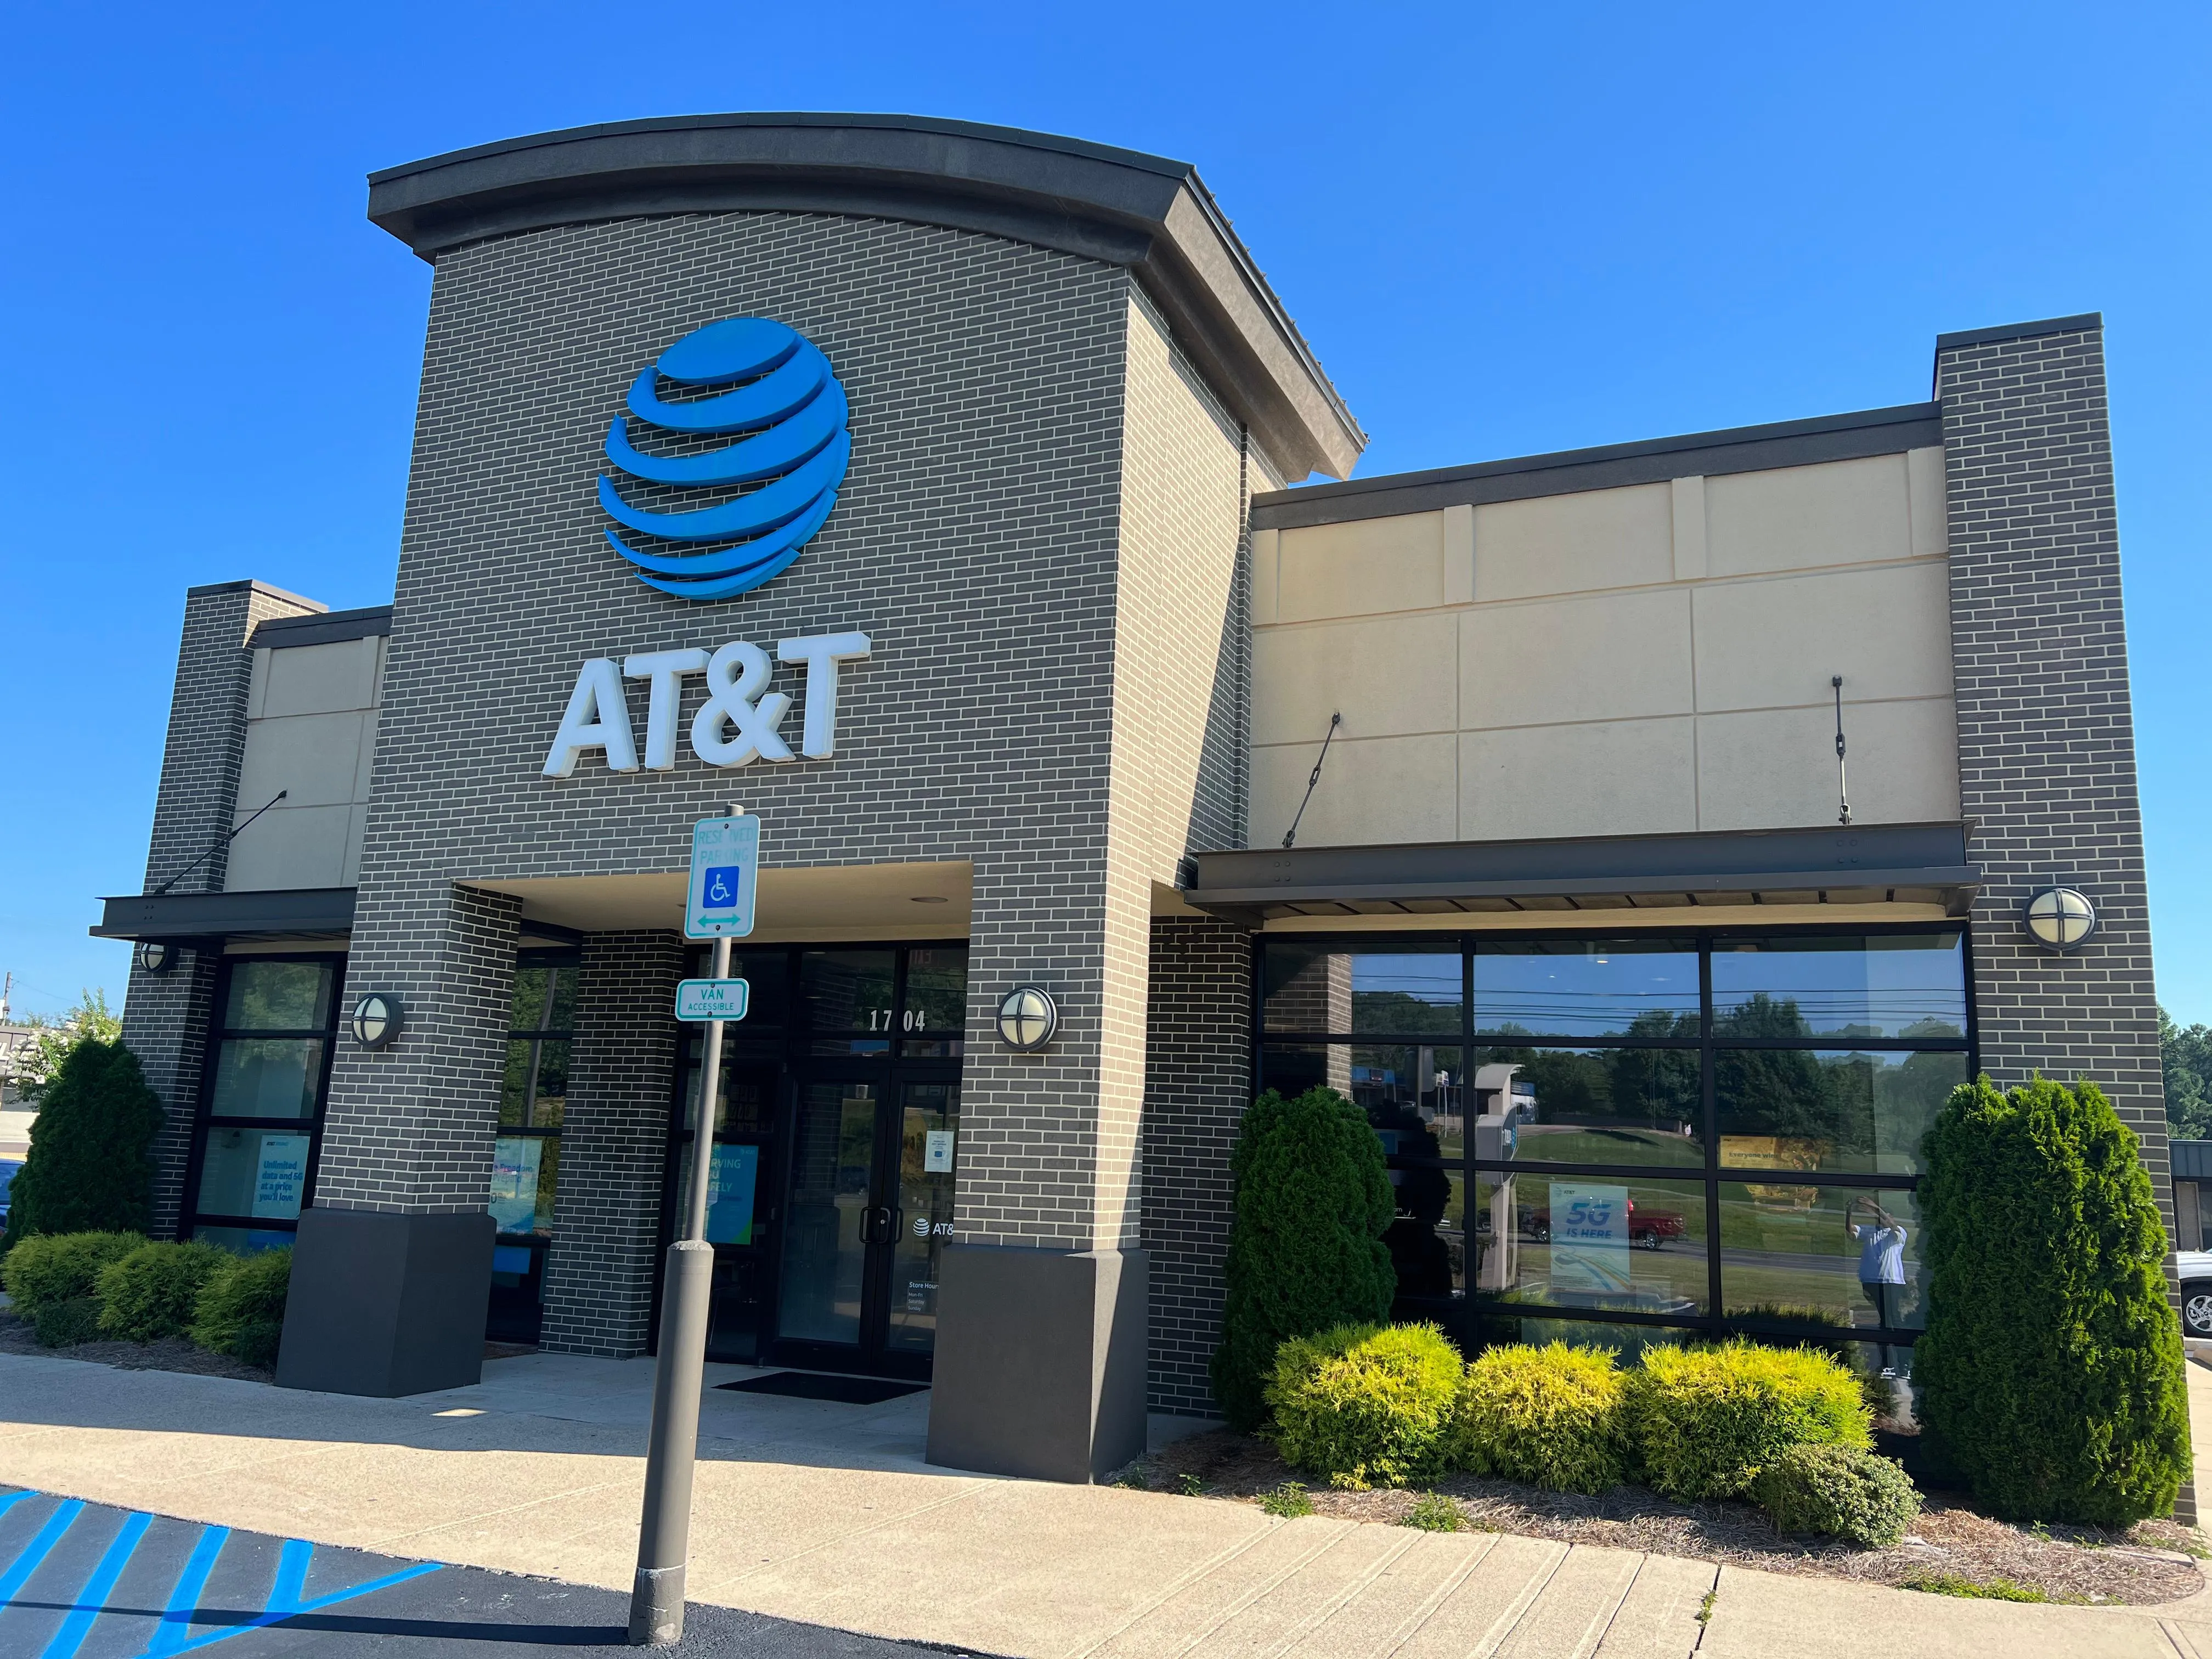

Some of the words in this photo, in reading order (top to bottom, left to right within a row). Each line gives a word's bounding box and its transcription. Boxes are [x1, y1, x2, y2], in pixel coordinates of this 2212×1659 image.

[542, 631, 871, 778] AT&T
[701, 989, 724, 1000] VAN
[264, 1161, 297, 1169] Unlimited
[500, 1164, 533, 1172] Freedom
[711, 1159, 741, 1169] RVING
[262, 1171, 278, 1179] data
[279, 1172, 292, 1180] and
[293, 1172, 303, 1181] 5G
[274, 1182, 292, 1193] price
[259, 1193, 278, 1202] you'll
[279, 1193, 294, 1201] love
[1566, 1202, 1611, 1226] 5G
[932, 1223, 953, 1235] AT&
[1567, 1228, 1578, 1238] IS
[1581, 1229, 1612, 1239] HERE
